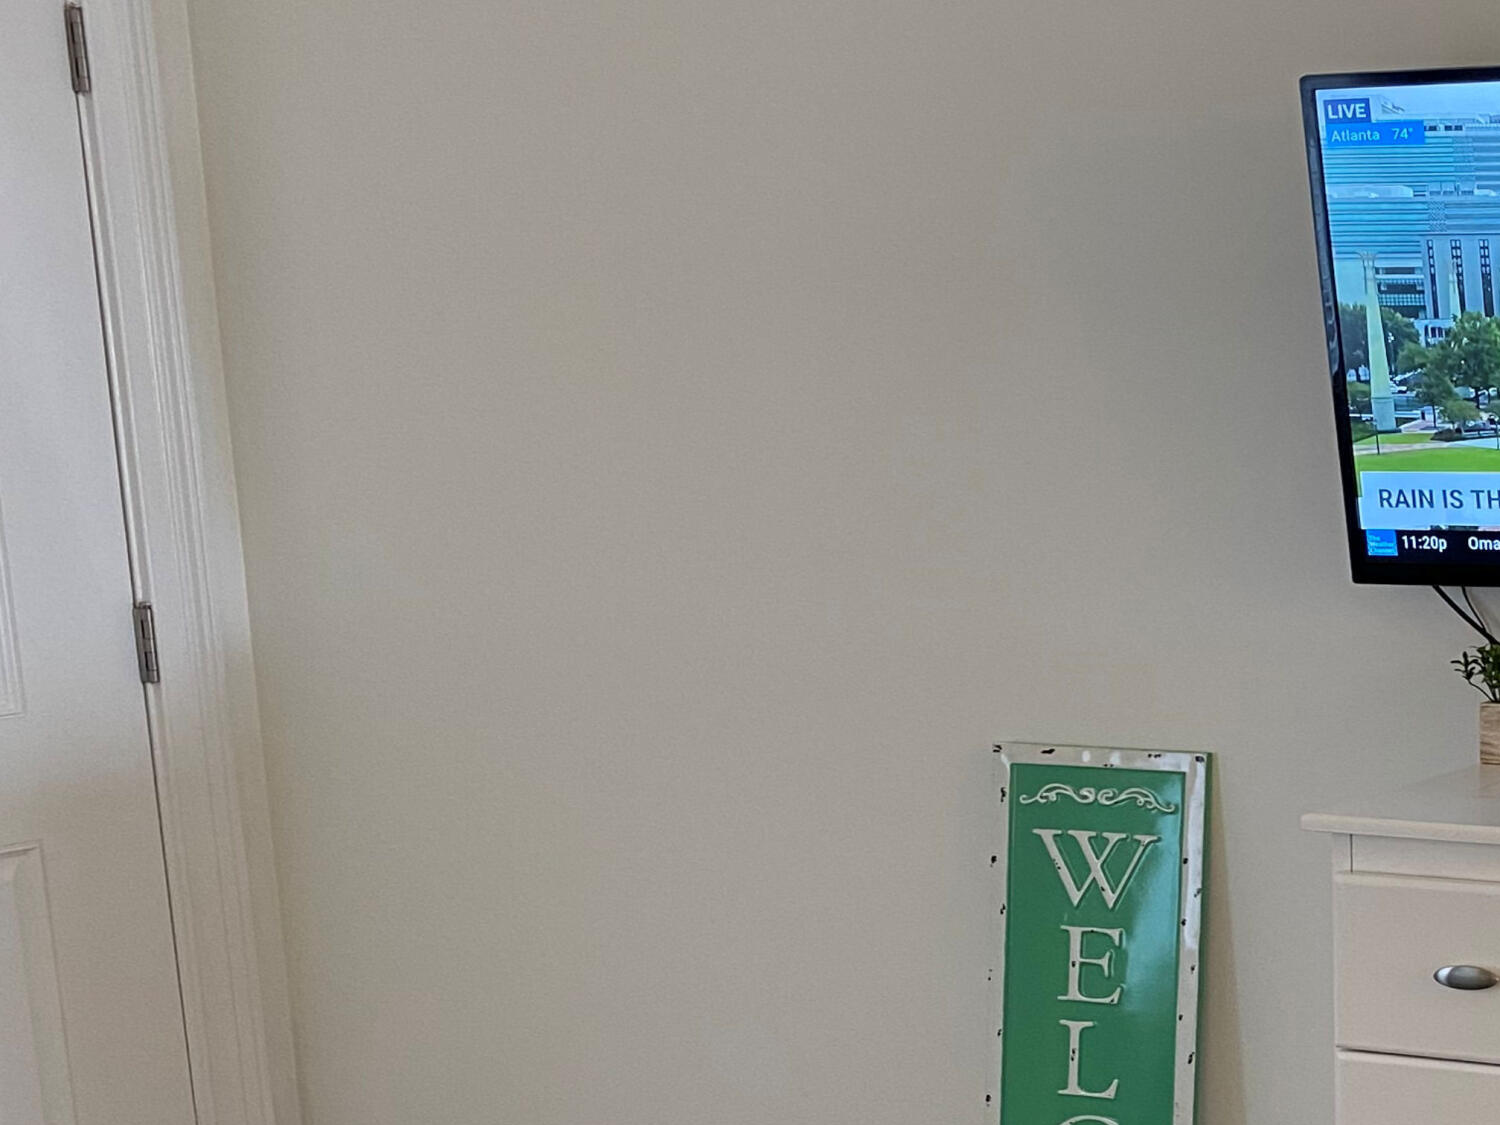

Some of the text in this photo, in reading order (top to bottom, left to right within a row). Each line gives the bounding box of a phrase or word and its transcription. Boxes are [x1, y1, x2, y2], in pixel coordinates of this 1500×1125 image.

[1327, 103, 1367, 119] LIVE
[1331, 127, 1414, 142] Atlanta 74°
[1378, 489, 1434, 509] RAIN
[1442, 489, 1464, 509] IS
[1401, 535, 1448, 553] 11:20p
